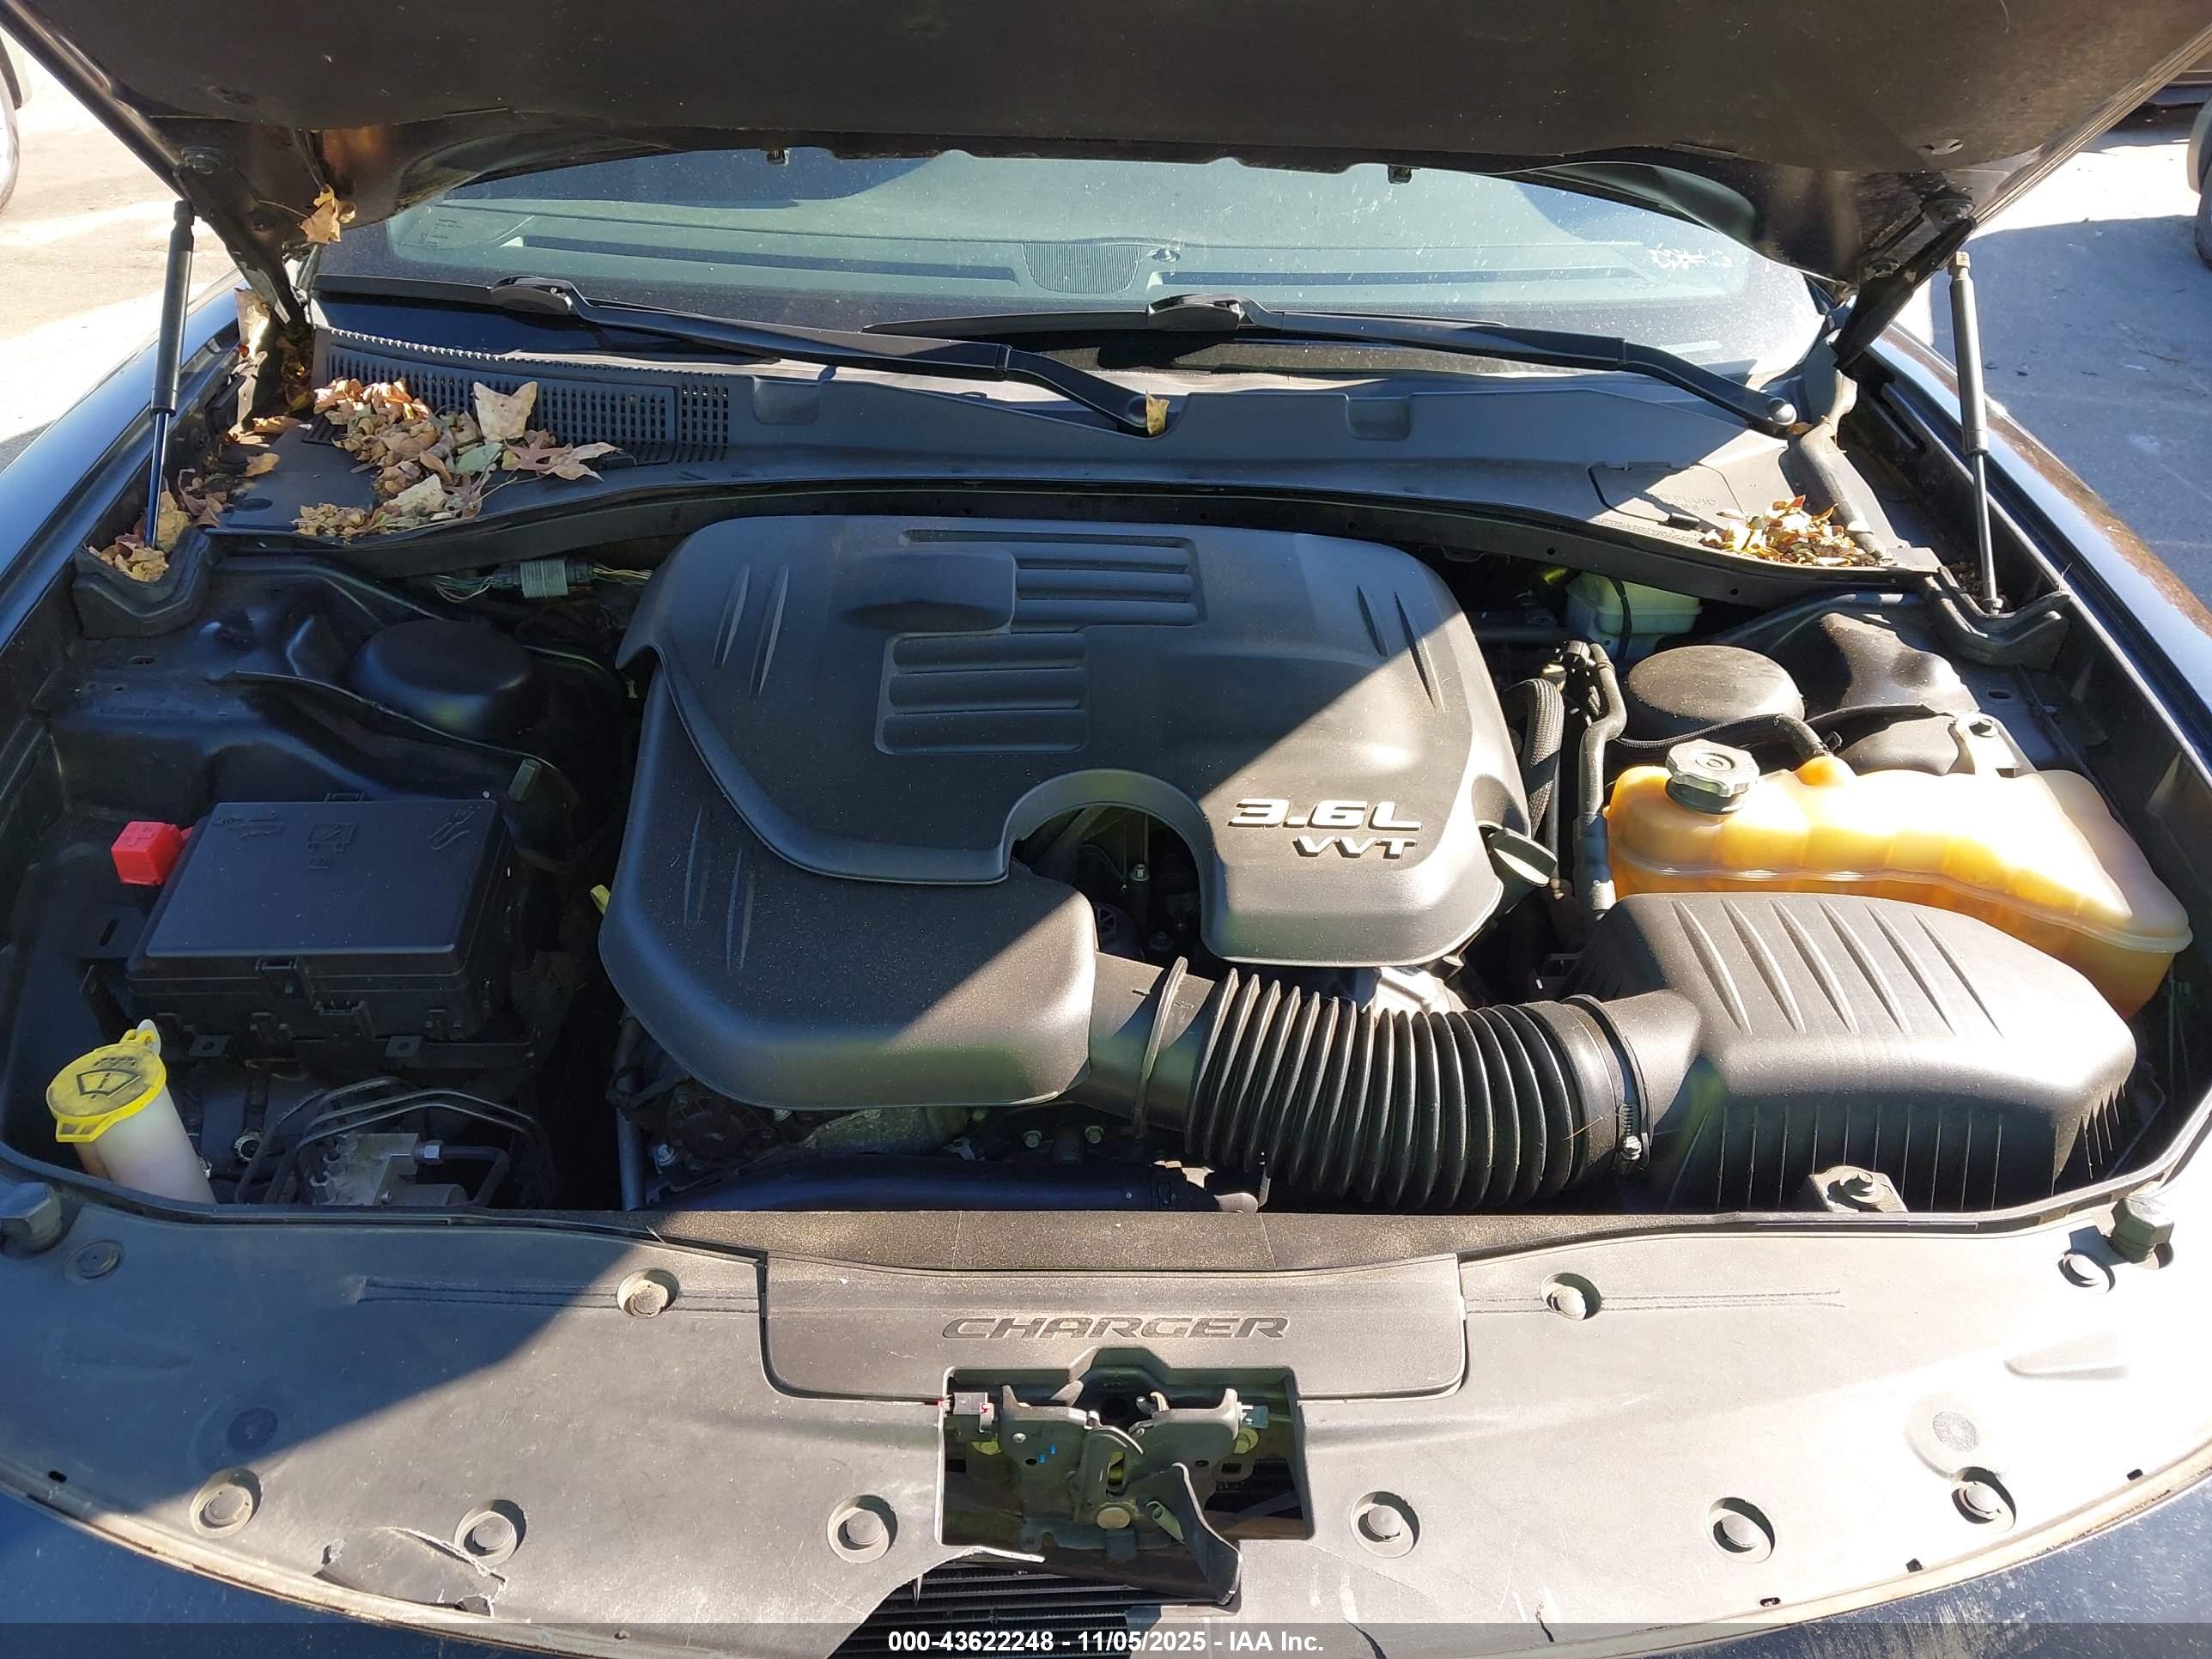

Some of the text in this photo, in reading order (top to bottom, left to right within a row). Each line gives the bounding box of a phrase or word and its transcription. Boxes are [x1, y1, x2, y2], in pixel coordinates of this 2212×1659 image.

[1671, 495, 1717, 506] FLUID
[1228, 798, 1423, 830] 3.6L
[1292, 836, 1417, 859] VVT
[942, 1316, 1289, 1340] CHARGER
